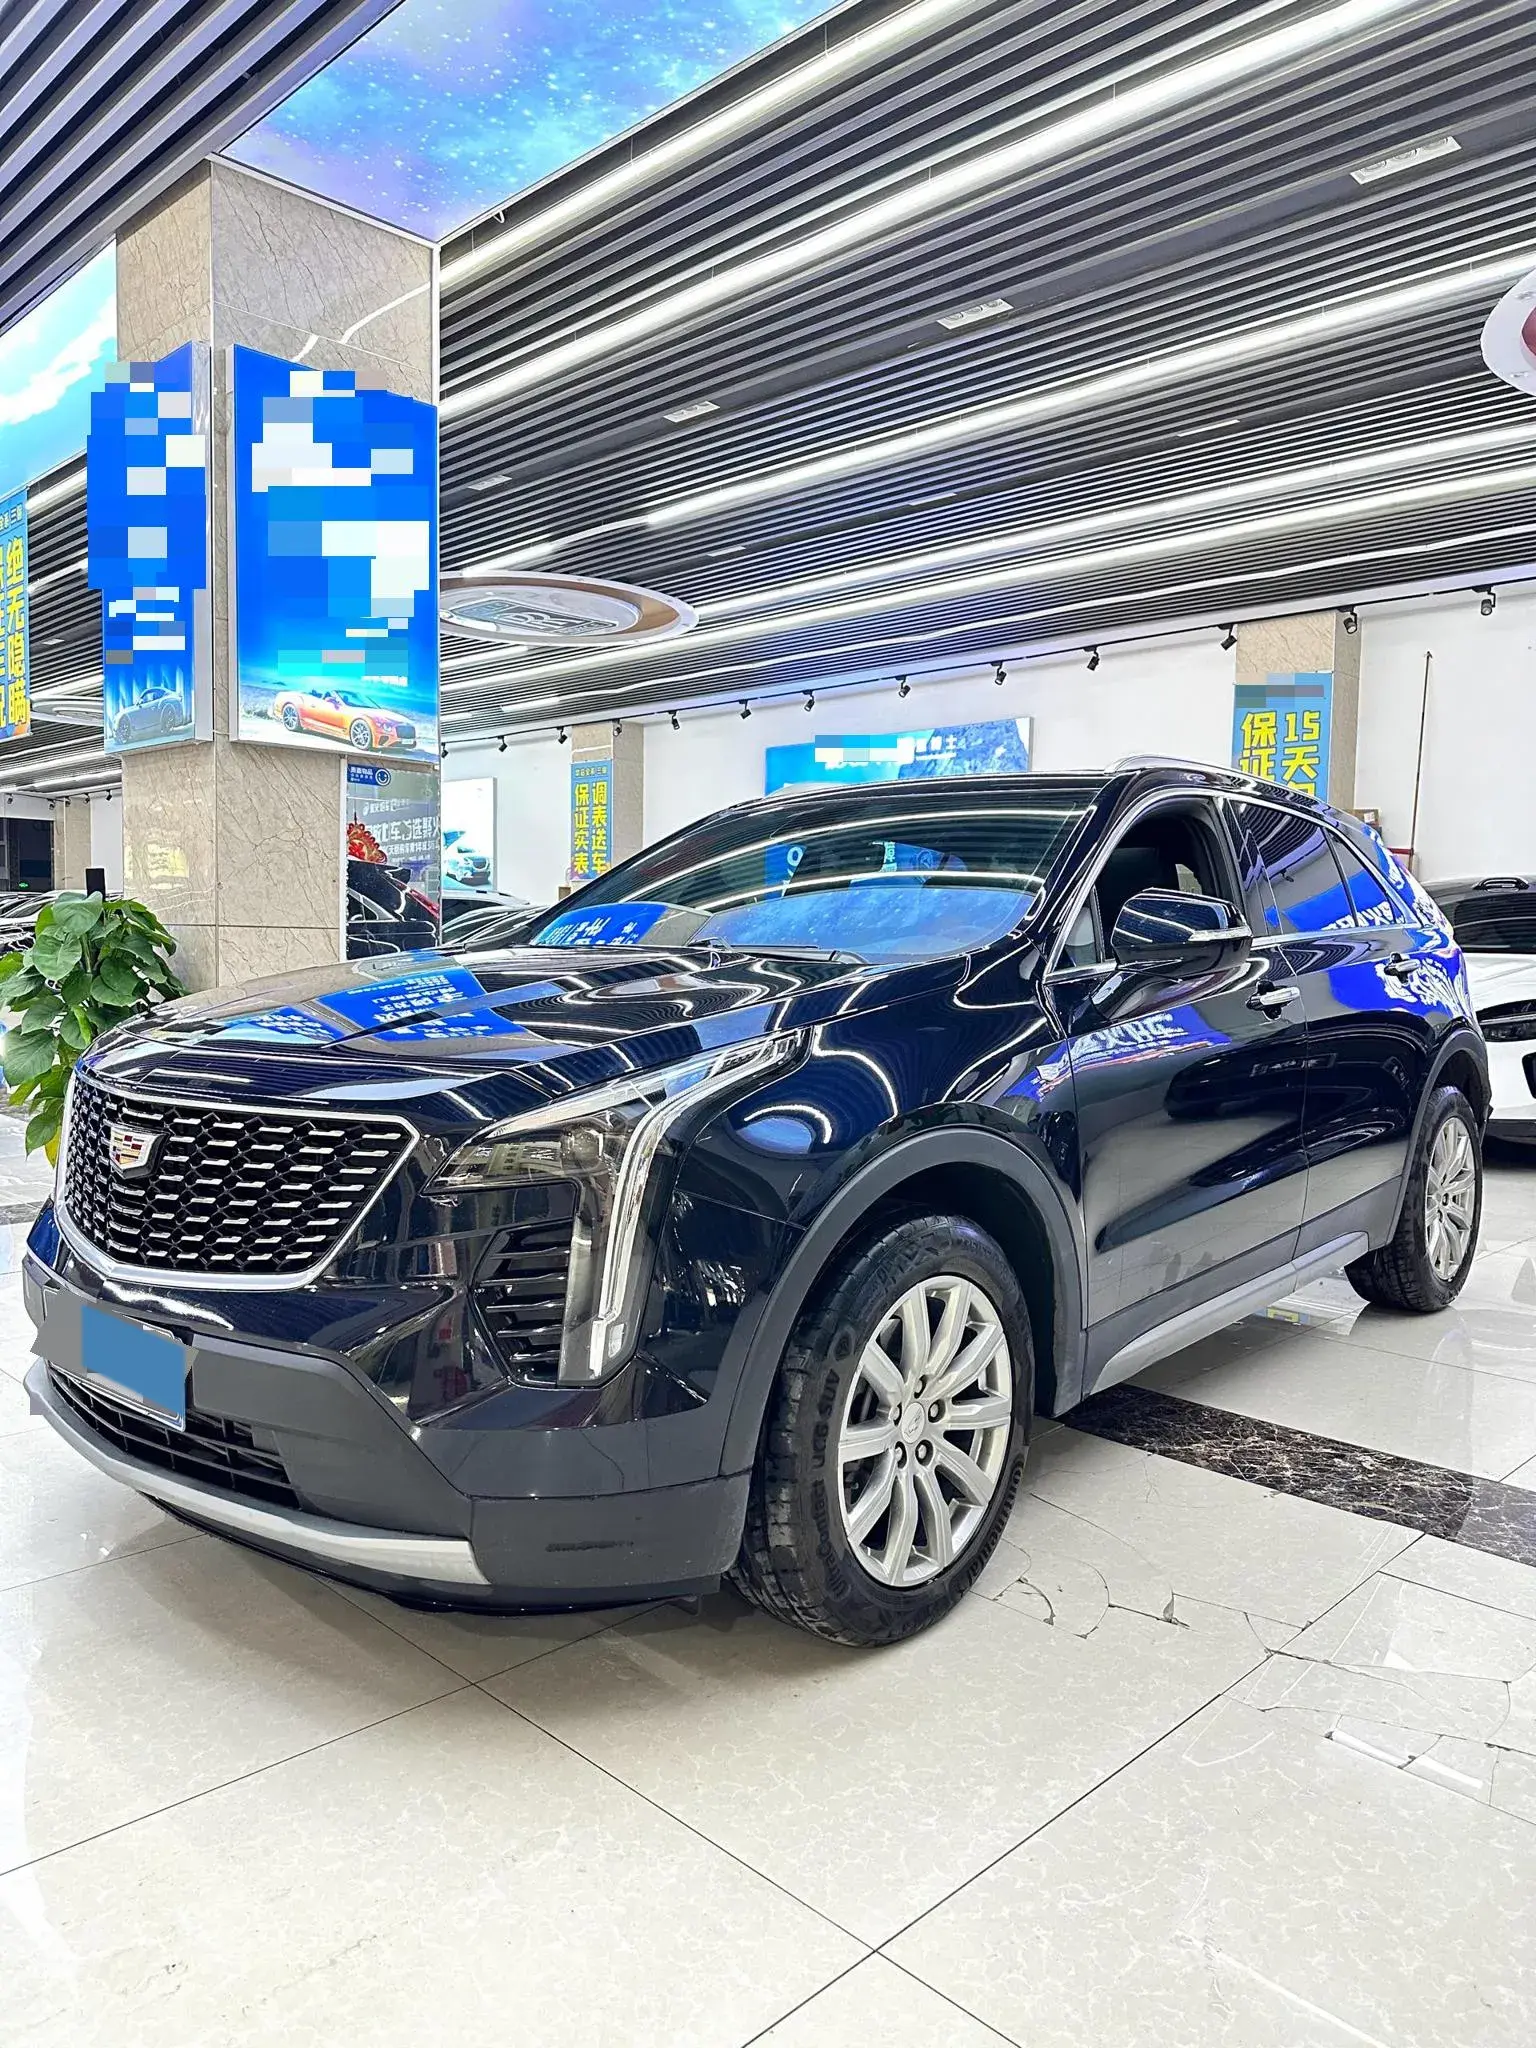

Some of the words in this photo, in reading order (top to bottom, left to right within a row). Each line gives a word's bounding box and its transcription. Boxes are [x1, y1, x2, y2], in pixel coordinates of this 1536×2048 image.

[6, 535, 27, 726] 绝无隐瞒
[1240, 711, 1278, 781] 保证
[574, 782, 590, 875] 保证实表
[591, 780, 608, 873] 调表送车
[817, 1367, 841, 1417] SUV
[810, 1480, 846, 1599] UltraContact
